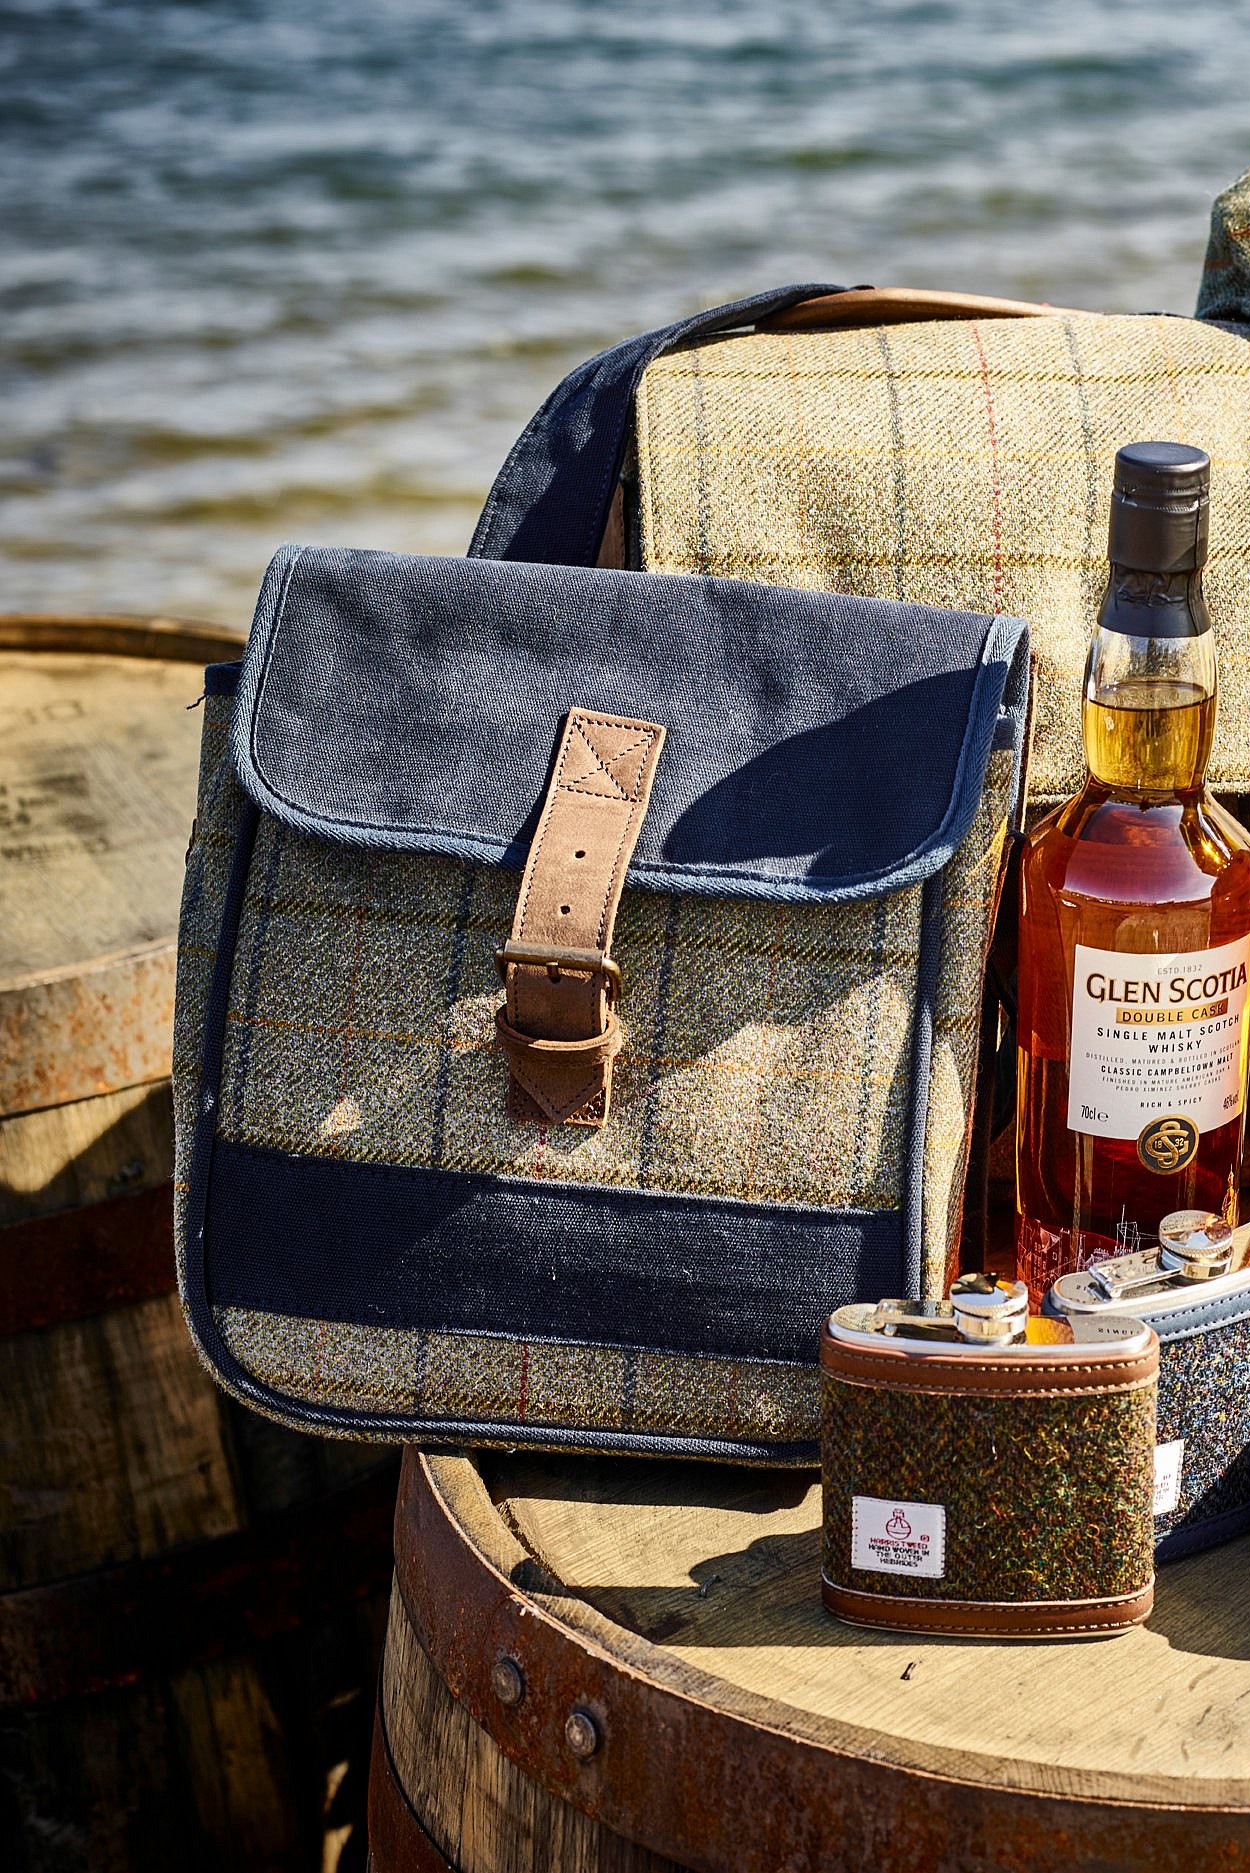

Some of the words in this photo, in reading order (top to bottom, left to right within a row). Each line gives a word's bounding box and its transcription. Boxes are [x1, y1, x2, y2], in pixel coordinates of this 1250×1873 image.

[1086, 973, 1161, 1004] GLEN
[1169, 961, 1248, 1004] SCOTIA
[1121, 1011, 1184, 1023] DOUBLE
[1190, 1003, 1224, 1020] CASK
[1097, 1027, 1148, 1041] SINGLE
[1157, 1029, 1193, 1041] MALT
[1199, 1014, 1240, 1036] SCOTCH
[1148, 1040, 1202, 1054] WHISKY
[1101, 1065, 1142, 1076] CLASSIC
[1147, 1061, 1214, 1077] CAMPBELTOWN
[1216, 1052, 1233, 1065] MALT
[1178, 1096, 1203, 1107] SPICY
[1081, 1105, 1096, 1121] 70cl
[1154, 1140, 1163, 1149] 18
[1175, 1137, 1184, 1147] 32
[892, 1547, 920, 1555] WOVEN
[901, 1541, 928, 1549] TWEED
